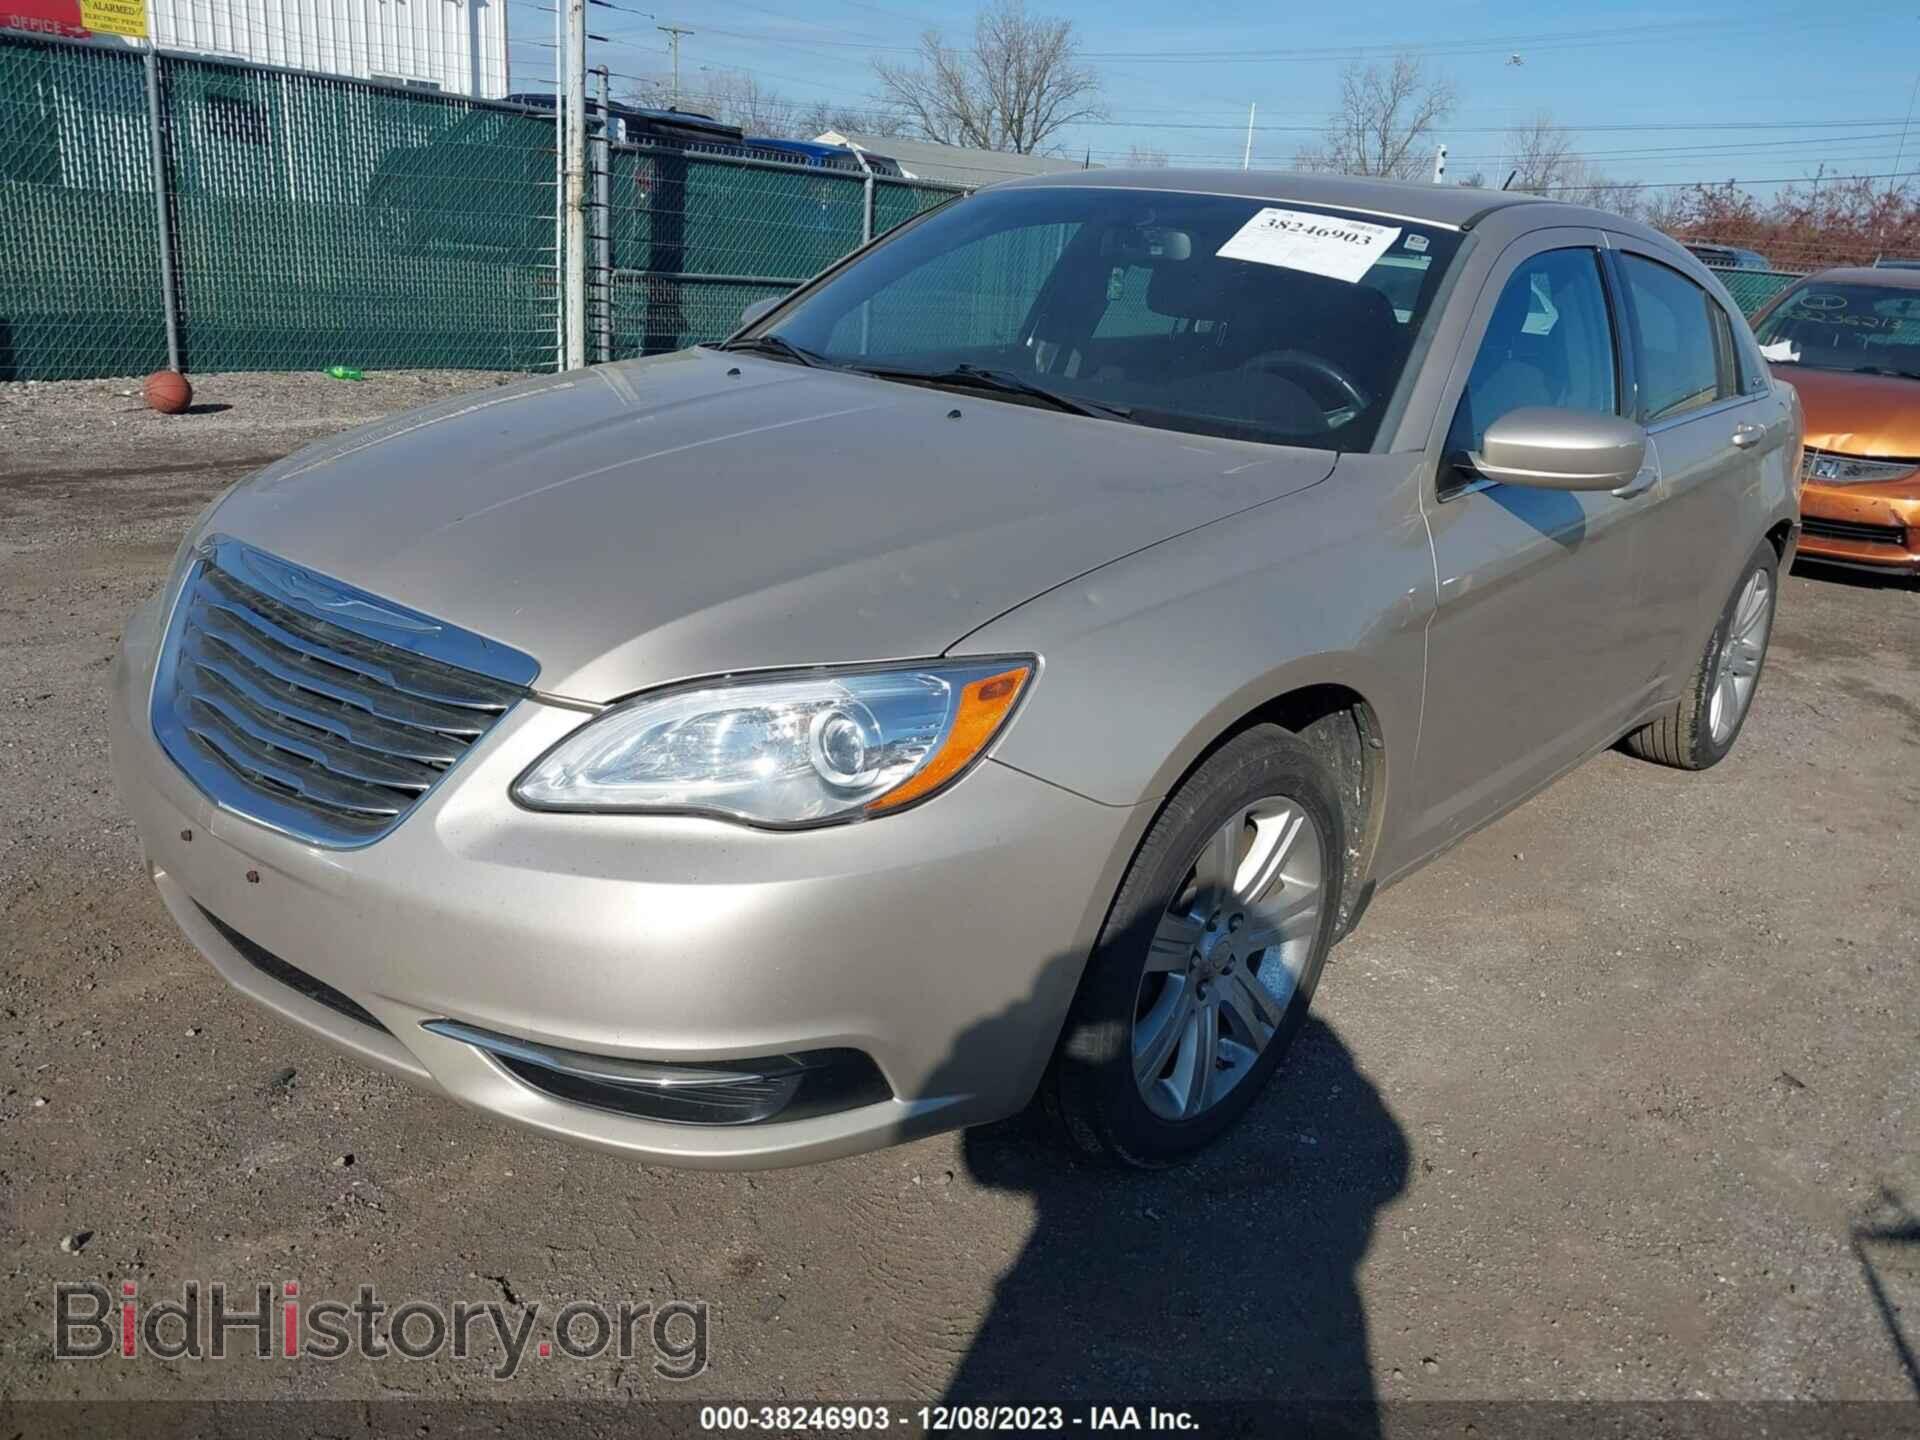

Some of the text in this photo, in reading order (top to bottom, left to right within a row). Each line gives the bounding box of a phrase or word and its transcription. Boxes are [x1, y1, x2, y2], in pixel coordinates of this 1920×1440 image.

[92, 1, 135, 16] ALARMED
[9, 15, 62, 33] OFFICE
[1260, 218, 1372, 245] 38246903
